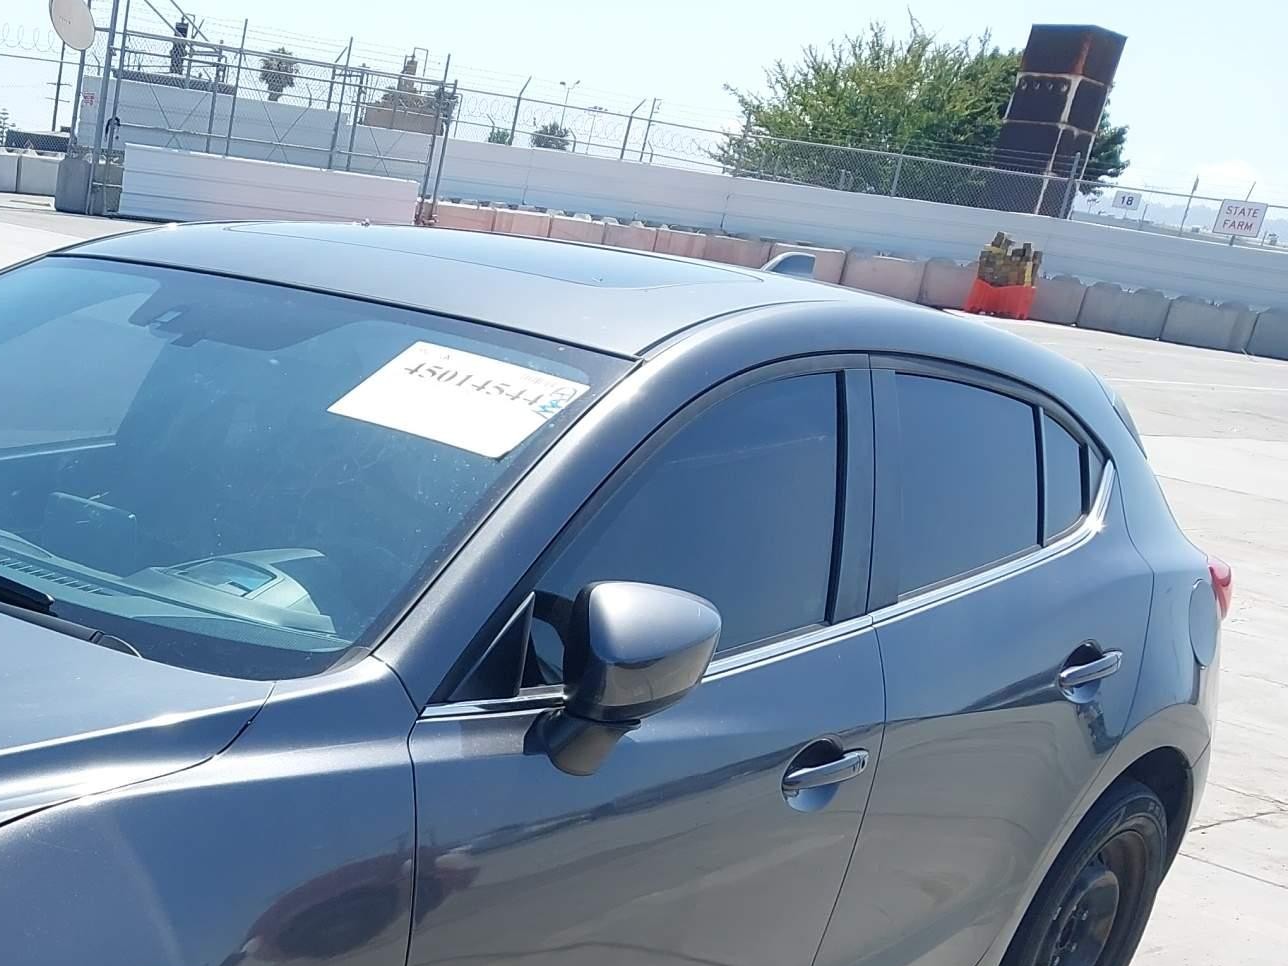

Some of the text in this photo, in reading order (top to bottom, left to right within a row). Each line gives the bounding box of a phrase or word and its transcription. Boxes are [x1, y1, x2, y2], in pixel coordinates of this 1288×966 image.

[1120, 195, 1134, 206] 18
[1225, 205, 1260, 218] STATE
[1222, 219, 1254, 232] FARM
[404, 362, 545, 406] 45014544
